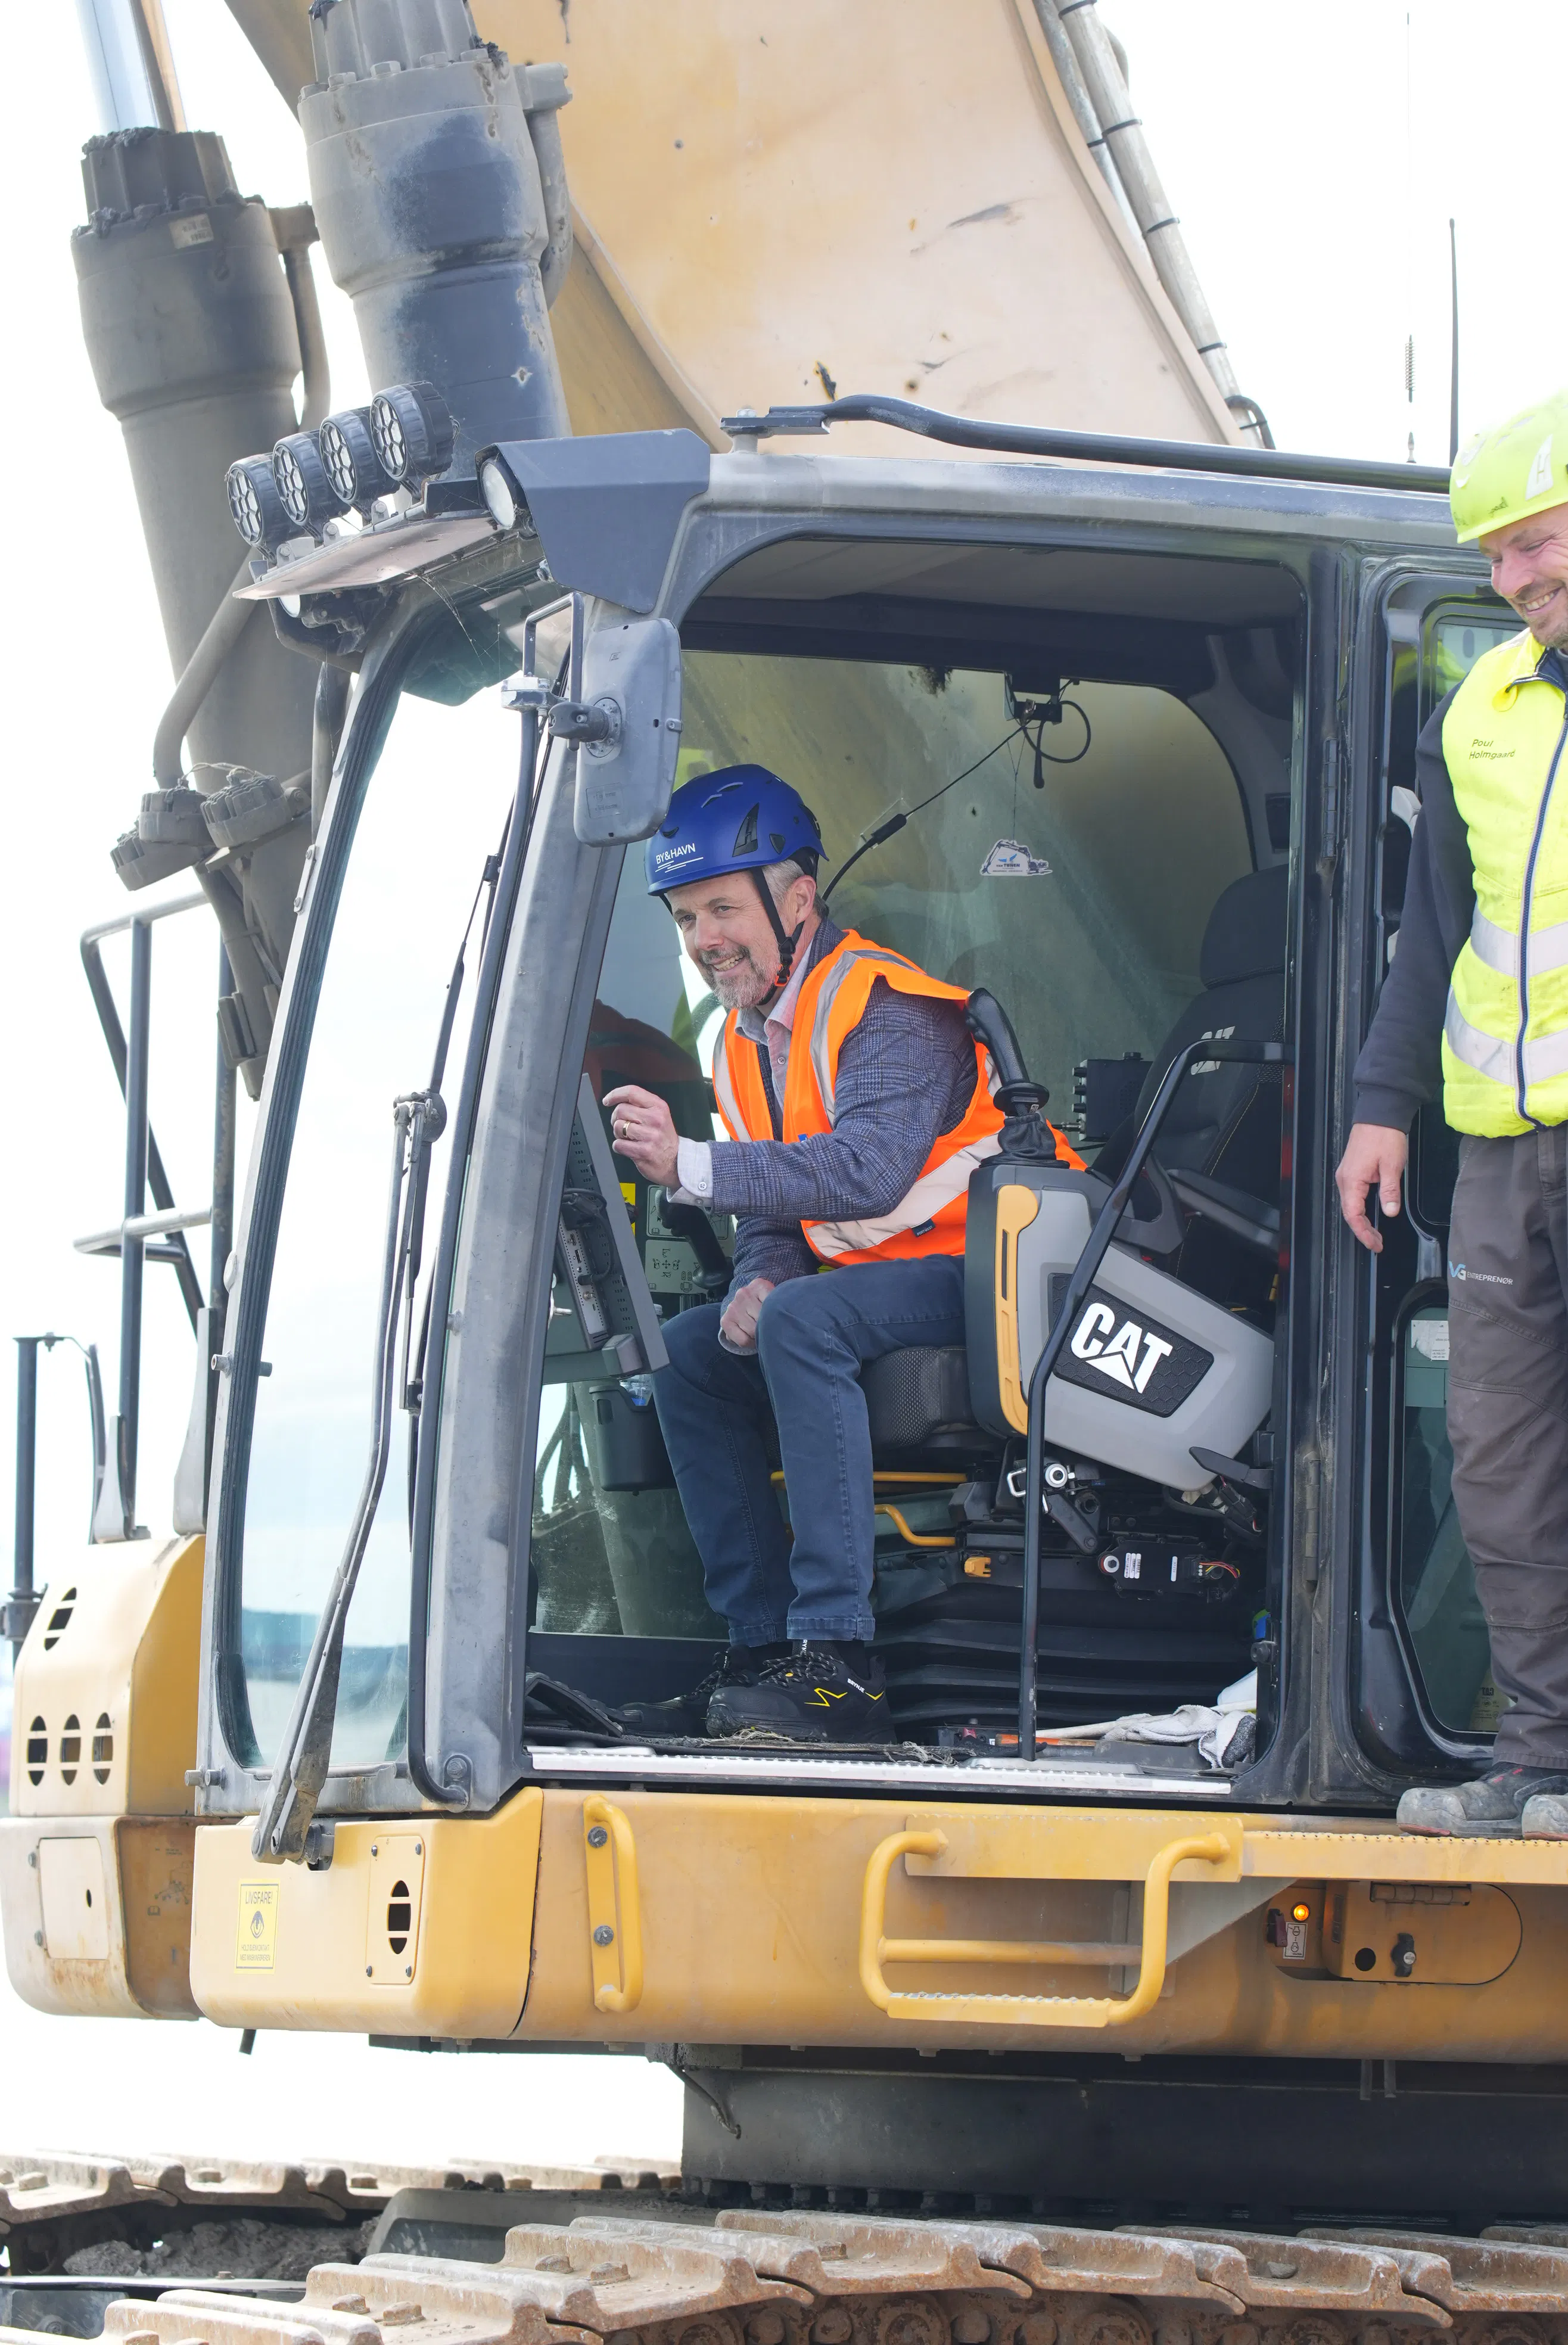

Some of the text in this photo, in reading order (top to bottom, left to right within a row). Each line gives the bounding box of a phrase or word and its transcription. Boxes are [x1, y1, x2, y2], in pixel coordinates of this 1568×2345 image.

[1471, 739, 1494, 748] Poul
[1469, 749, 1516, 760] Holmgaard
[656, 843, 696, 865] BY&HAVN
[1467, 1271, 1513, 1286] ENTREPRENØR
[1071, 1302, 1173, 1394] CAT
[847, 1678, 866, 1694] BRYNJE
[245, 1890, 273, 1905] LIVSFARE!
